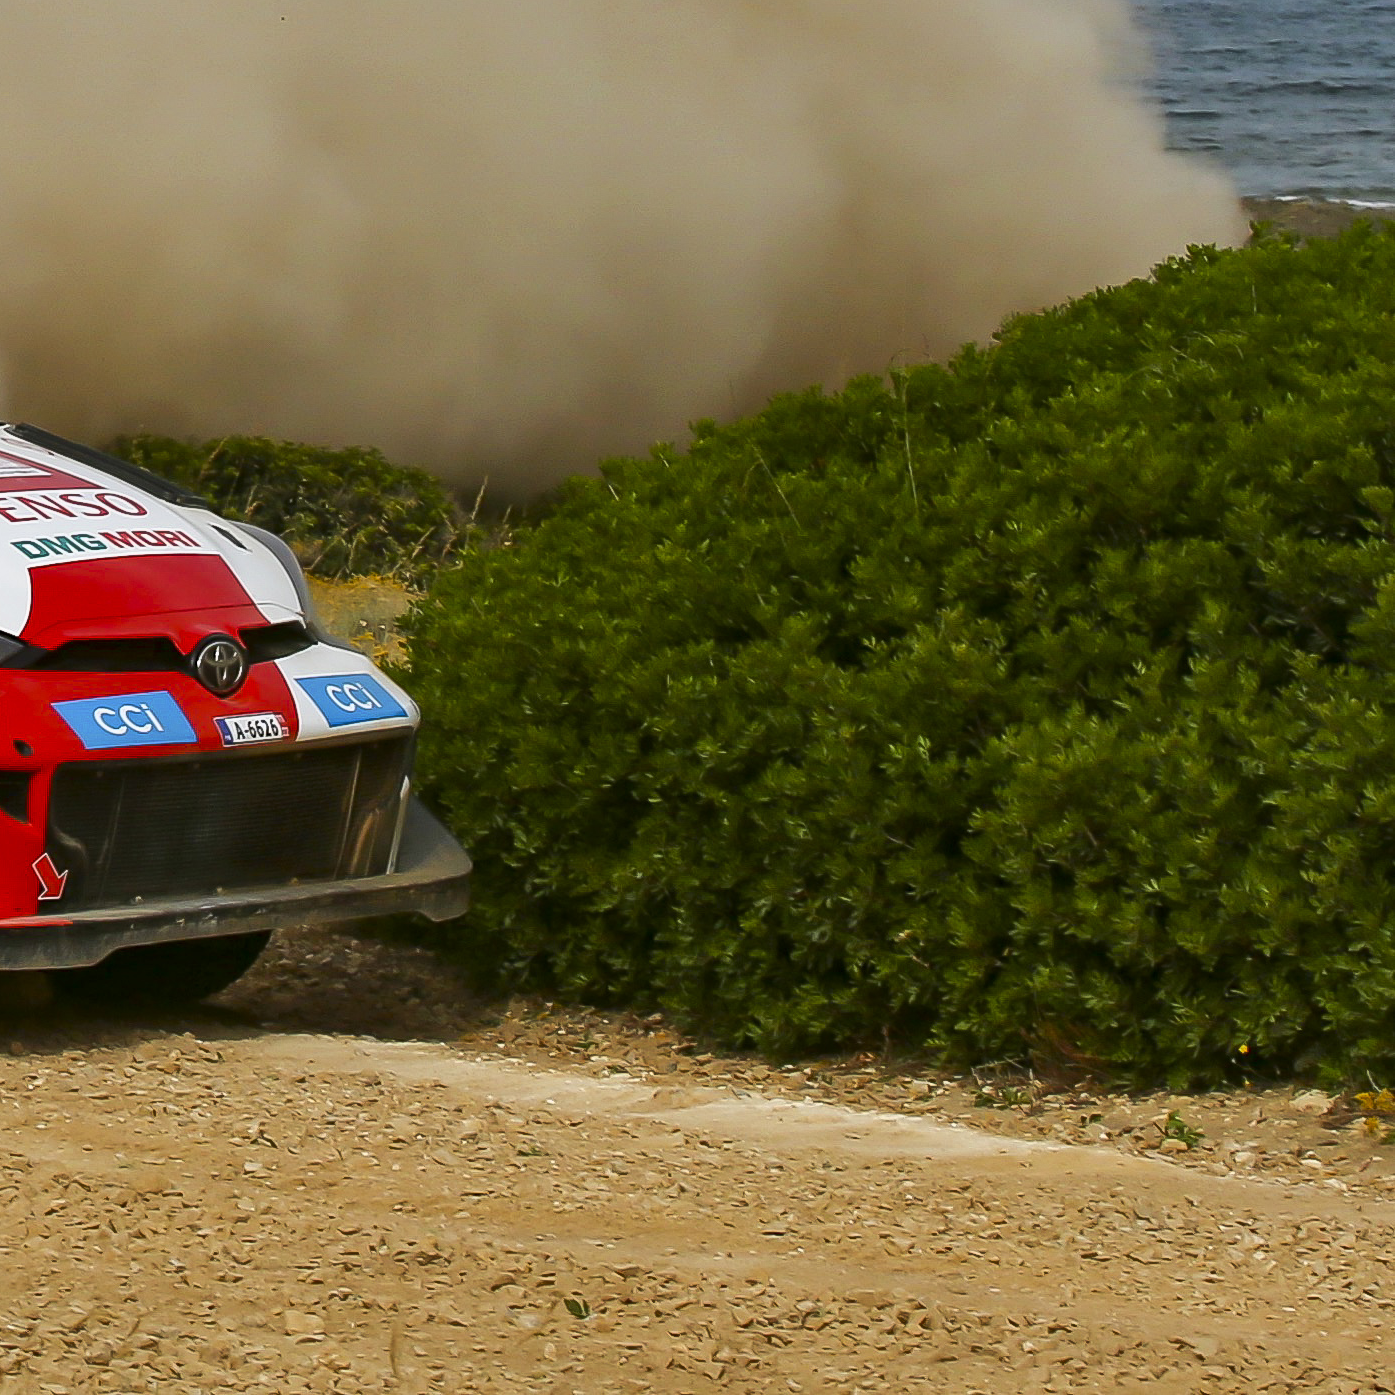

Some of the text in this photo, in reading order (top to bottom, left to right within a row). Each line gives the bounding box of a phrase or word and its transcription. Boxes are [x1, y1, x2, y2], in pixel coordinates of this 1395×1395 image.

[10, 530, 202, 560] DMG MORI
[234, 719, 279, 740] A-6626
